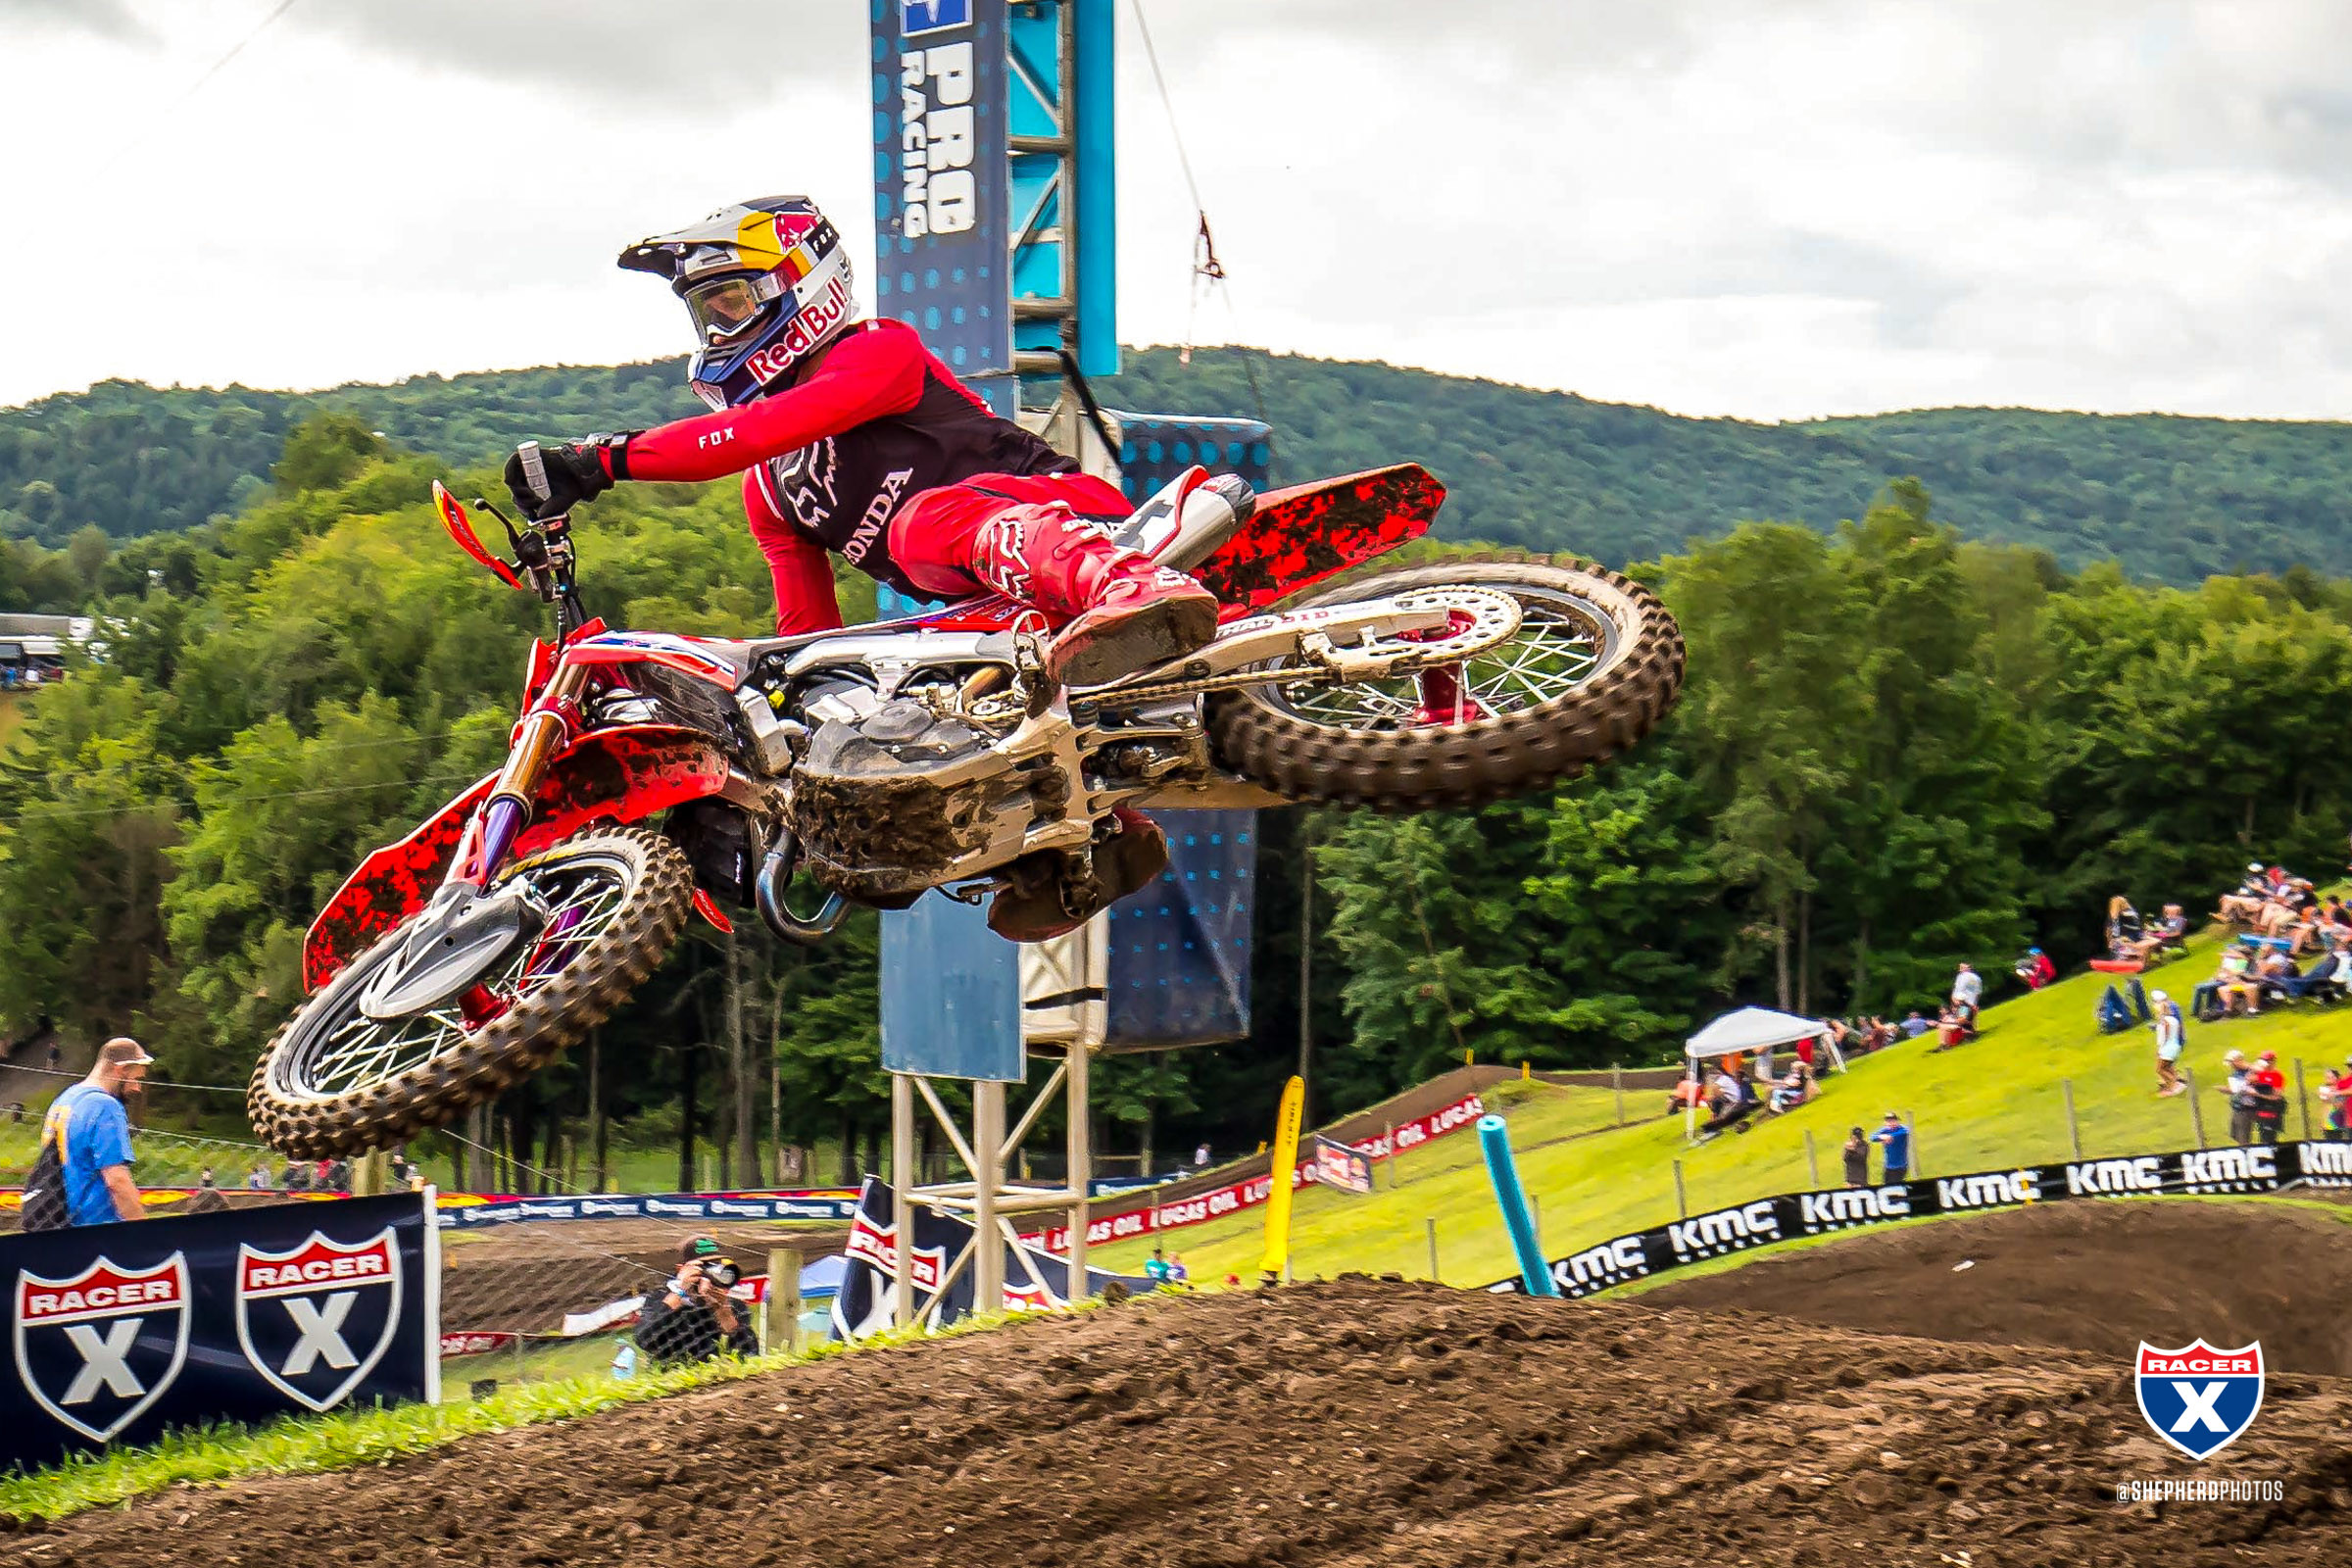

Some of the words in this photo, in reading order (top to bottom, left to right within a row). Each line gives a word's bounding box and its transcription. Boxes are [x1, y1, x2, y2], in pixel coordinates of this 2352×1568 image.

[901, 49, 929, 239] RACING
[925, 41, 975, 234] PRO
[746, 317, 812, 386] Red
[799, 274, 849, 339] Bull
[698, 426, 735, 450] FOX
[1668, 1200, 1778, 1253] KMC
[1800, 1185, 1911, 1224] KMC
[2065, 1156, 2163, 1196] KMC
[2180, 1146, 2278, 1184] KMC
[2298, 1142, 2352, 1175] KM
[249, 1253, 384, 1288] RACER
[848, 1229, 936, 1280] RACR
[28, 1280, 173, 1315] RACER
[280, 1291, 361, 1376] X
[60, 1318, 147, 1404] X
